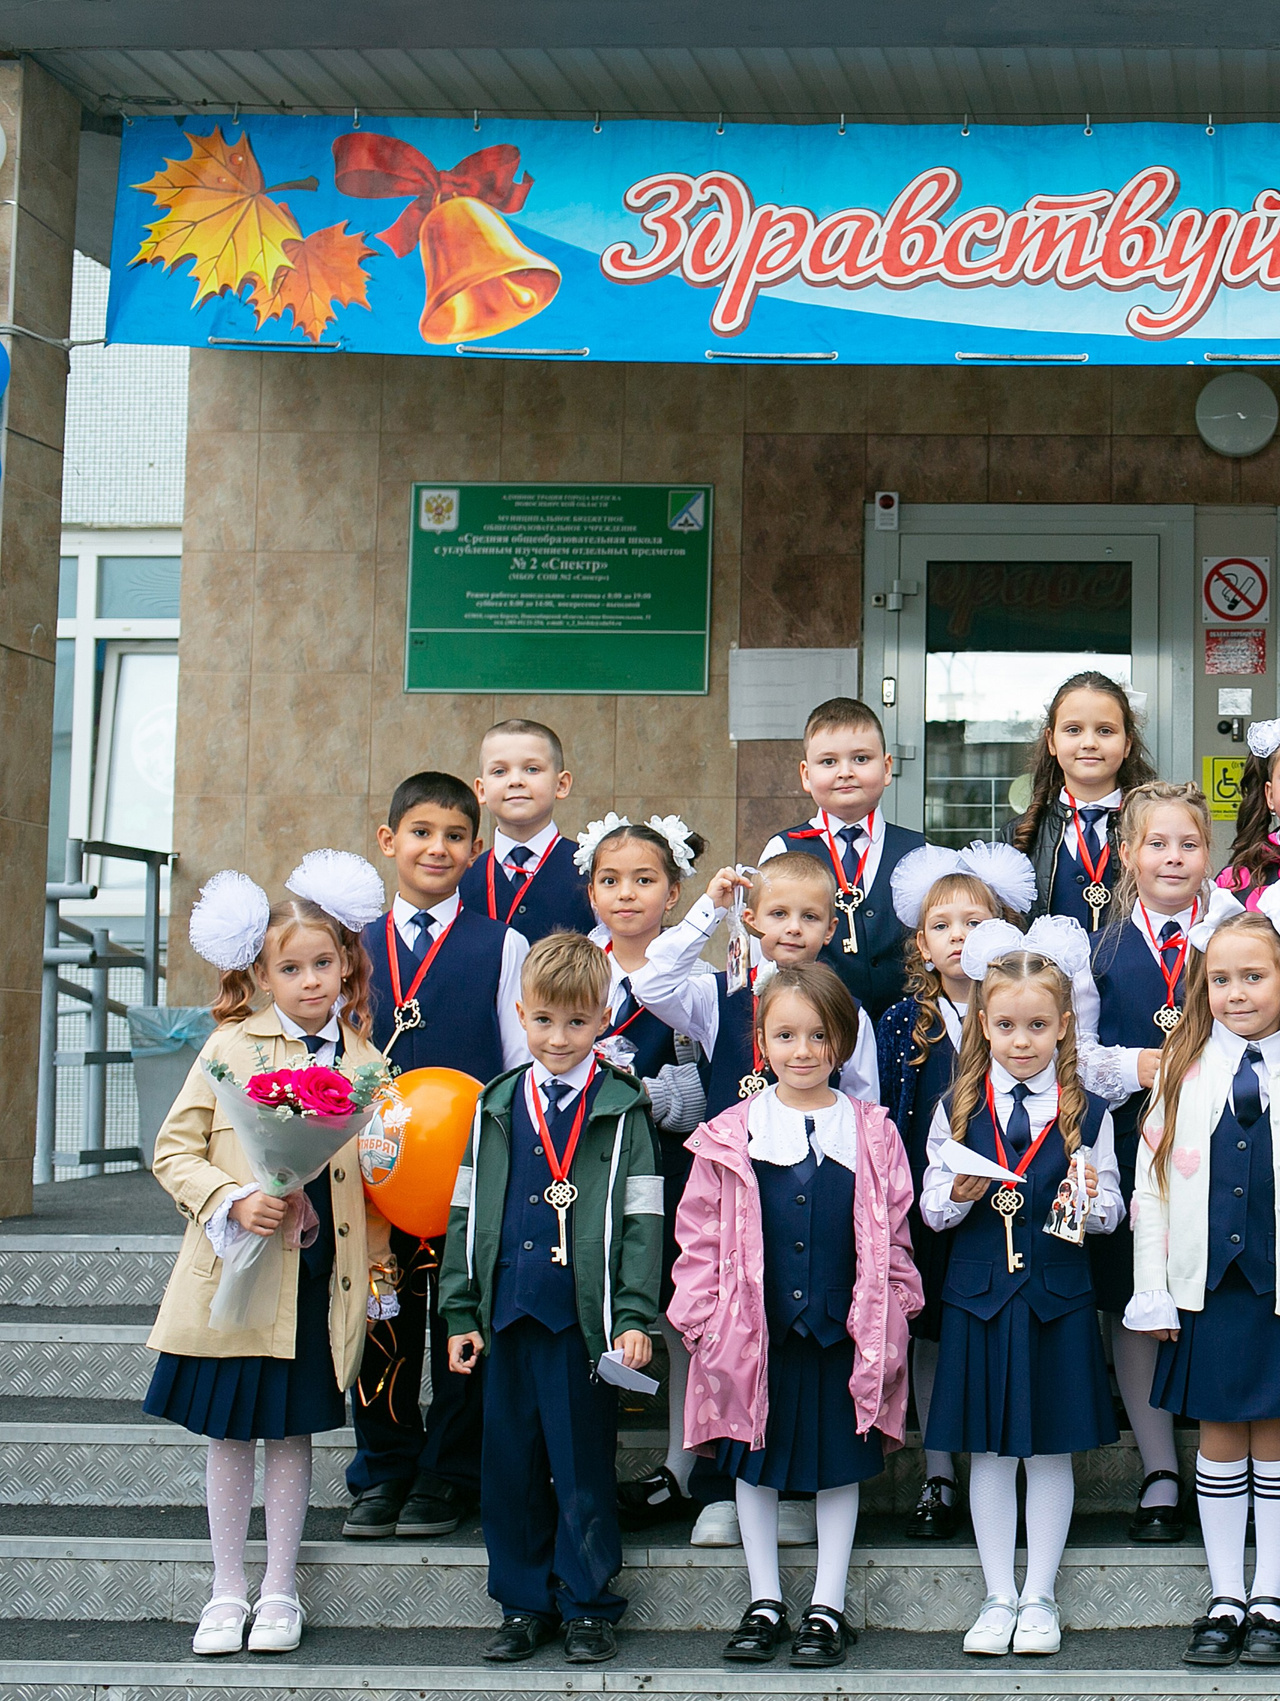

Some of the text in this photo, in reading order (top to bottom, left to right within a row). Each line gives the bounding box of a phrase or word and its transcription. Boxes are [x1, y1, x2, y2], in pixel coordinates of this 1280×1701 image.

[510, 557, 609, 573] № 2 «Спектр»
[358, 1138, 395, 1157] ТЯБРЯ!
